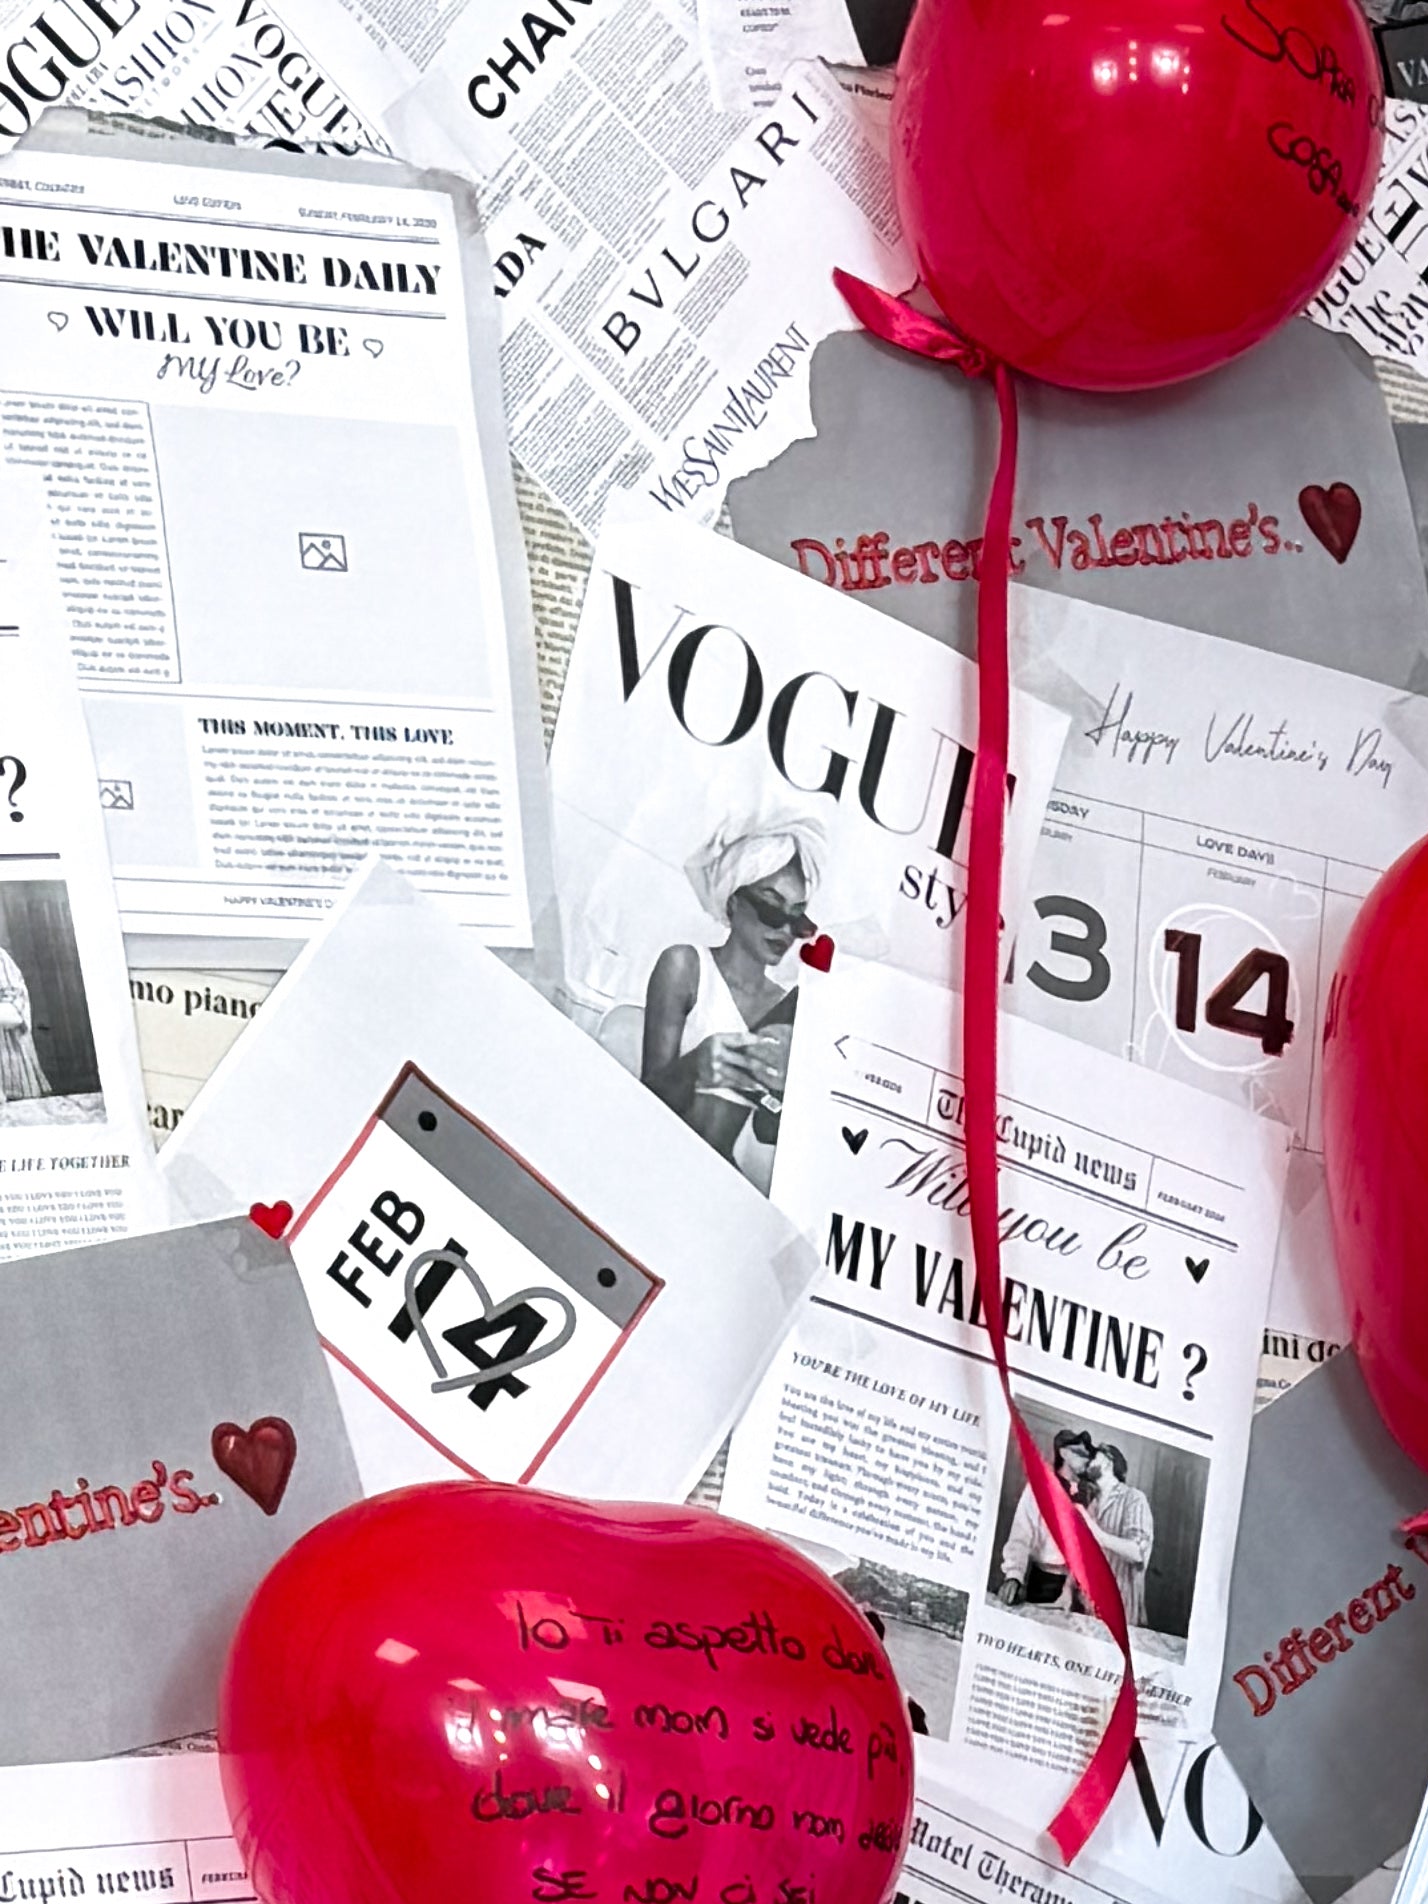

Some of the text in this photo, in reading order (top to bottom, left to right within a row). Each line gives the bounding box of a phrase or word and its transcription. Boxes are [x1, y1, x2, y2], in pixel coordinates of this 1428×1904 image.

[603, 91, 819, 356] BVLGARI
[77, 233, 441, 295] VALENTINE DAILY
[84, 306, 350, 357] WILL YOU BE
[403, 726, 454, 747] LOVE
[1085, 682, 1180, 763] Happy
[1204, 712, 1329, 773] Valentine's
[1161, 927, 1296, 1058] 14
[49, 1154, 131, 1173] TOGETHER
[1074, 1153, 1139, 1194] news
[327, 1189, 427, 1308] FEB
[824, 1211, 897, 1294] MY
[1097, 1222, 1151, 1282] be
[389, 1237, 548, 1412] 14
[791, 1352, 846, 1382] YOU'RE
[846, 1373, 874, 1391] THE
[876, 1380, 911, 1401] LOVE
[645, 1609, 805, 1670] aspetto
[1232, 1563, 1417, 1719] Different
[97, 1866, 175, 1896] news
